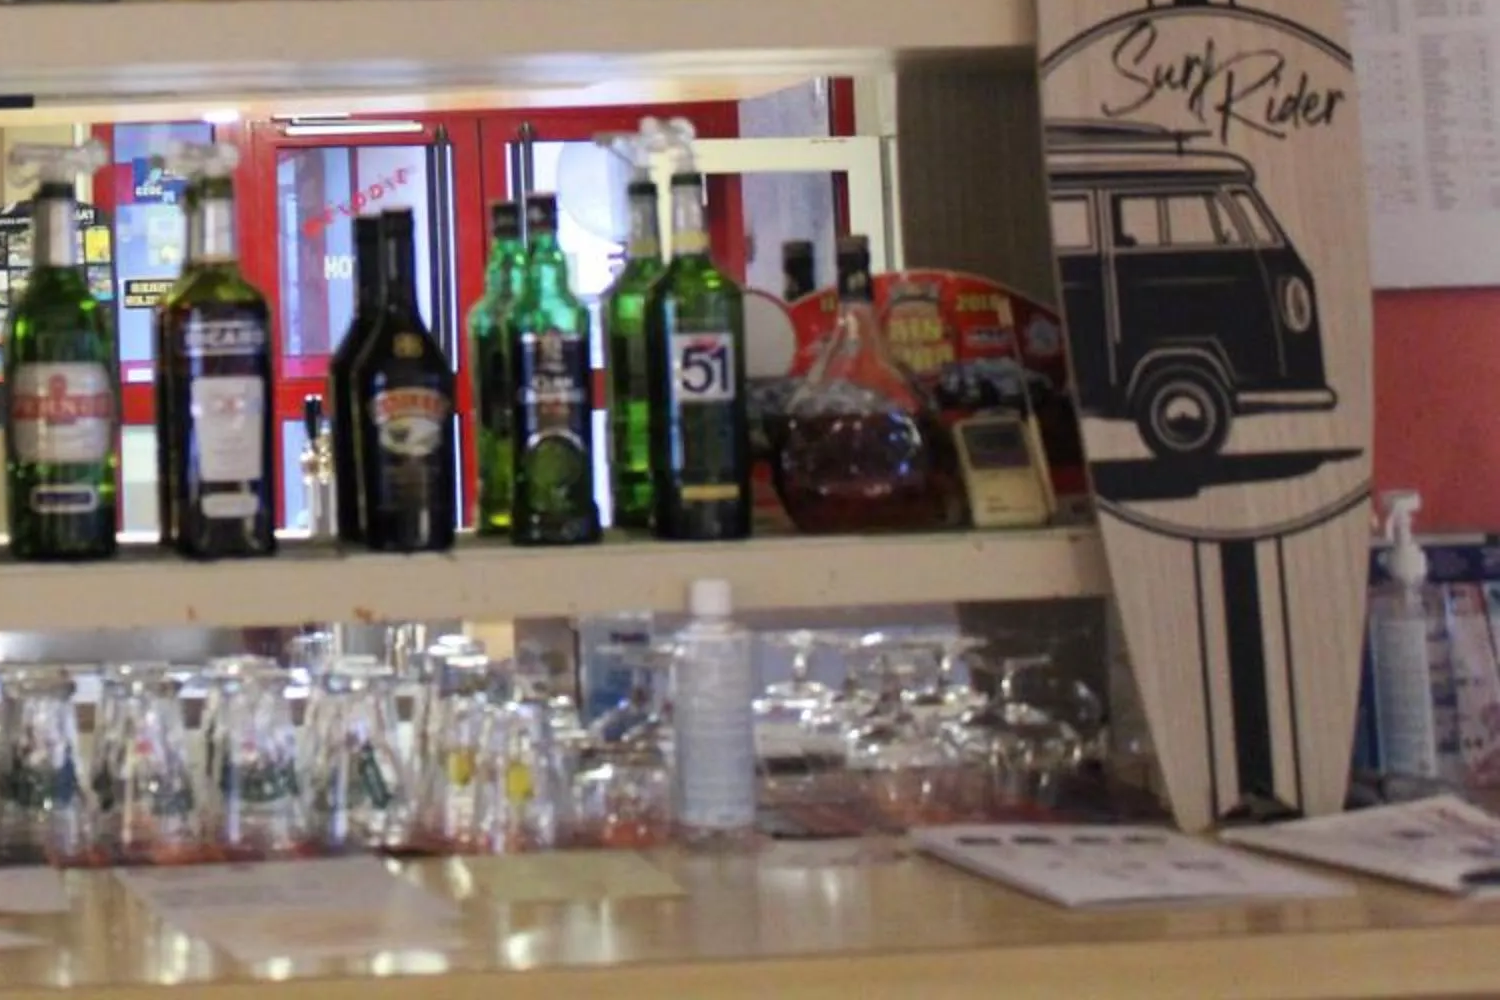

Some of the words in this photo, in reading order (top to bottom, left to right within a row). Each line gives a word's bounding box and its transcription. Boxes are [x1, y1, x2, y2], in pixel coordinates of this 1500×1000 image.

[1102, 20, 1217, 123] Surf
[1214, 49, 1345, 145] Rider
[681, 346, 731, 394] 51
